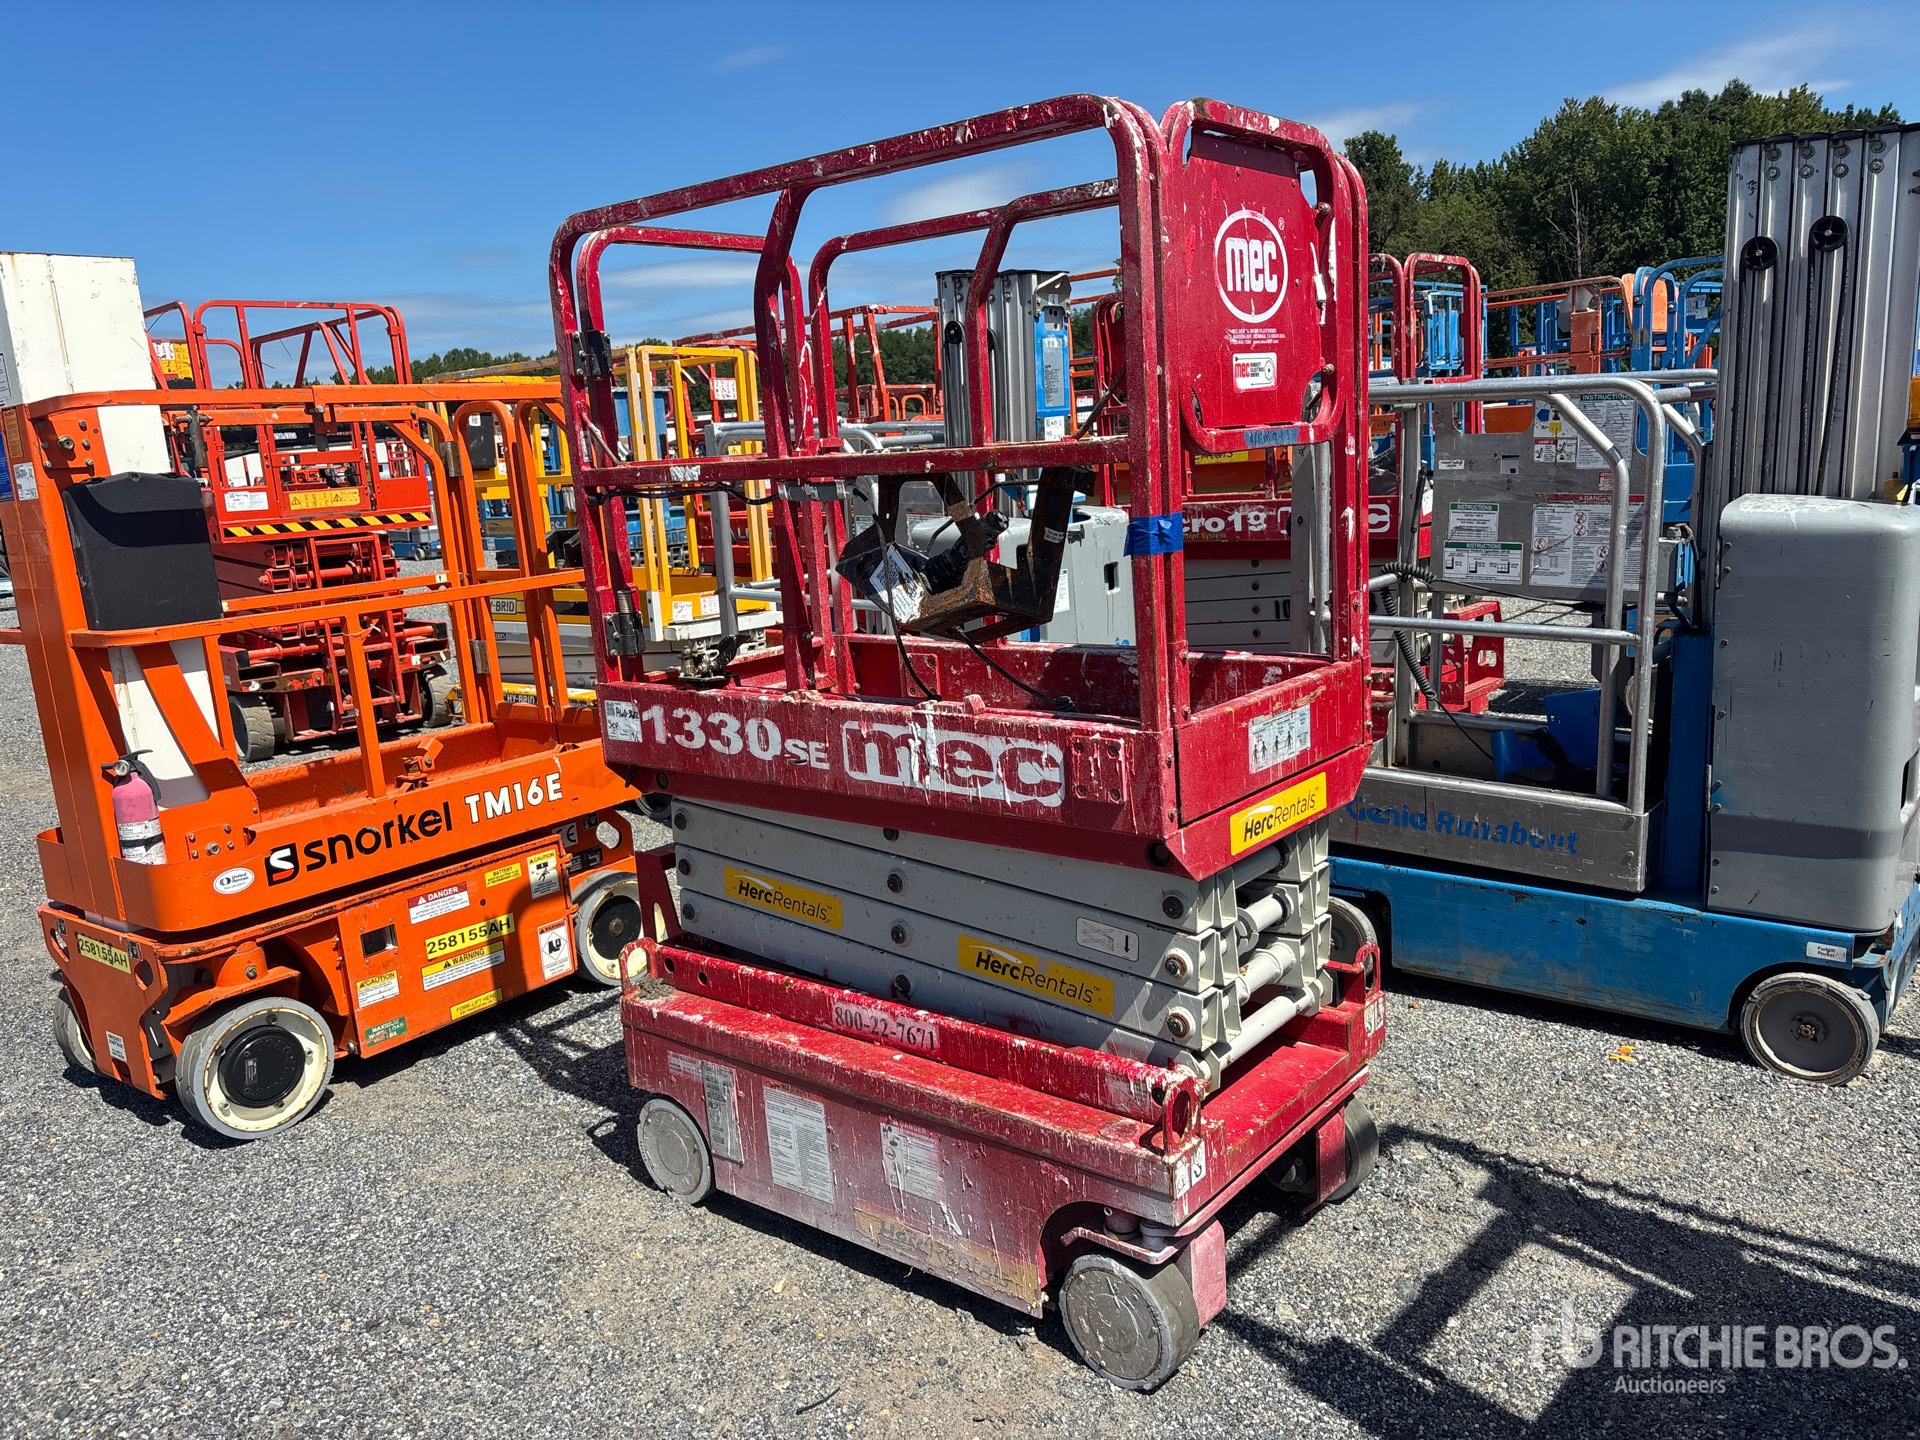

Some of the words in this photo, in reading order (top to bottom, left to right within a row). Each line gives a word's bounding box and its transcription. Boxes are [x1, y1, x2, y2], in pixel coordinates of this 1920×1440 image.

[303, 801, 453, 873] snorkel
[464, 772, 563, 824] TM16E
[428, 886, 459, 901] DANGER
[426, 917, 511, 955] 258155AH
[452, 948, 485, 966] WARNING
[365, 972, 395, 985] CAUTION
[834, 1006, 935, 1051] 800-22-7671
